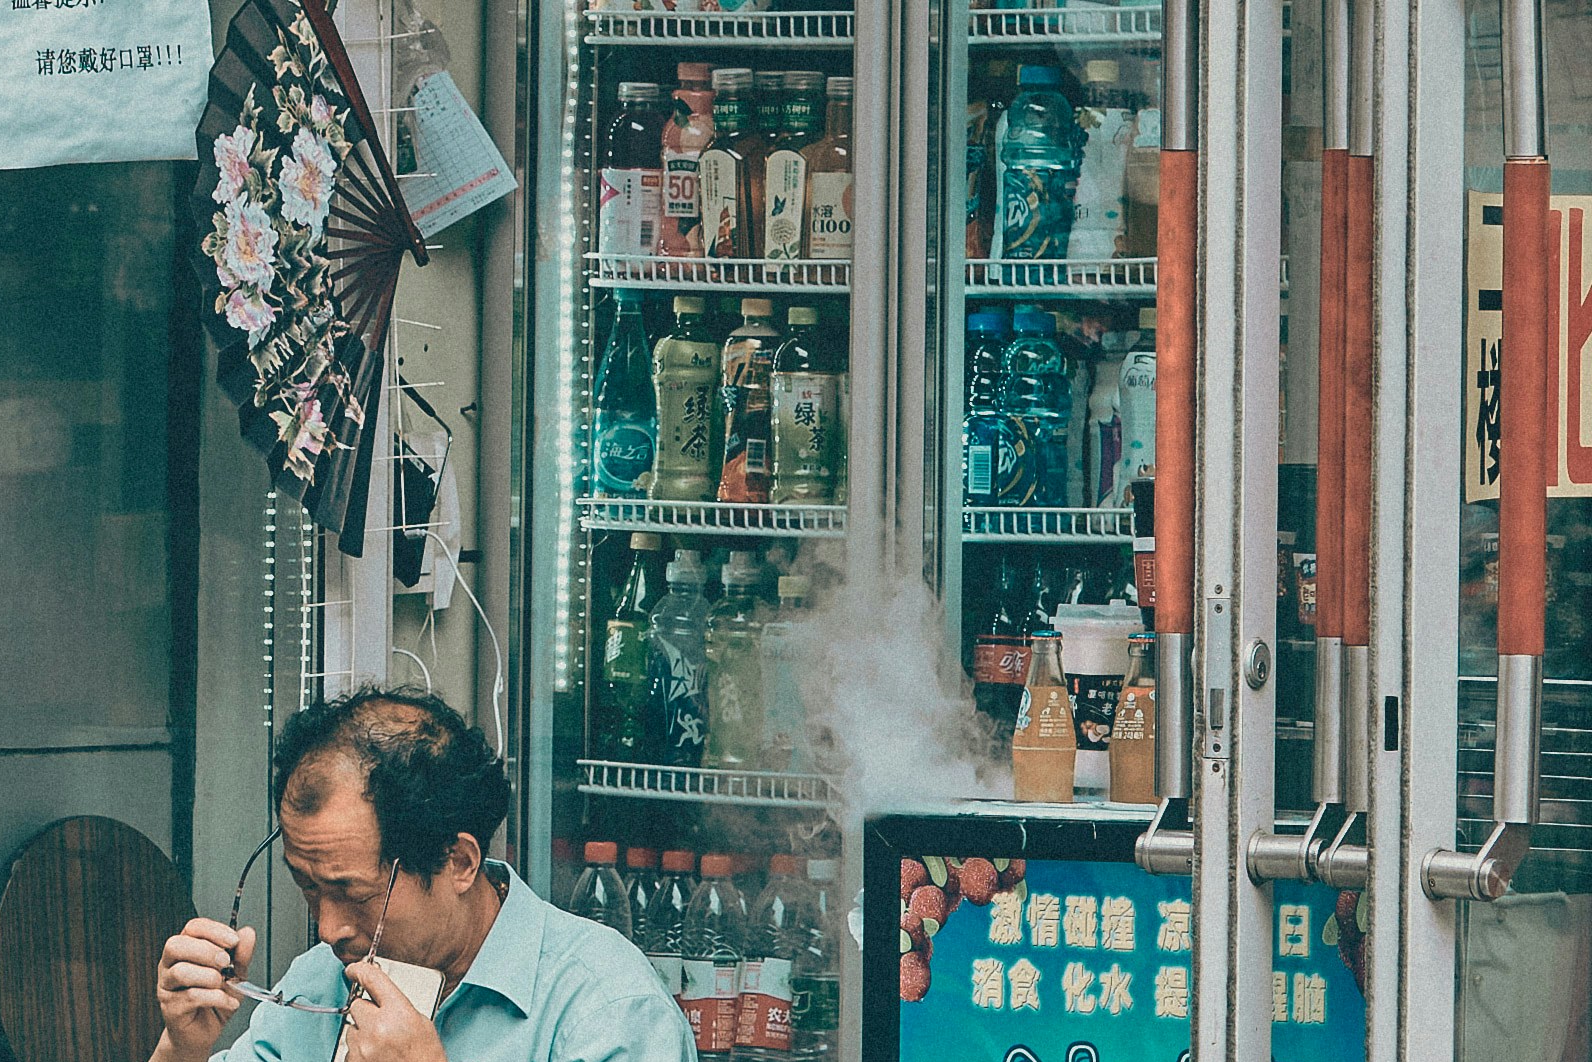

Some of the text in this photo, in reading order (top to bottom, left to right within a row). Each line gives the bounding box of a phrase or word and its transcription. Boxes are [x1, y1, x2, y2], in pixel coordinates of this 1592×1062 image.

[36, 44, 182, 75] 请您戴好口罩!!!
[668, 175, 695, 200] 50
[793, 401, 826, 451] 绿茶
[989, 892, 1136, 951] 激情碰撞
[971, 957, 1041, 1011] 消食
[1061, 961, 1134, 1015] 化水
